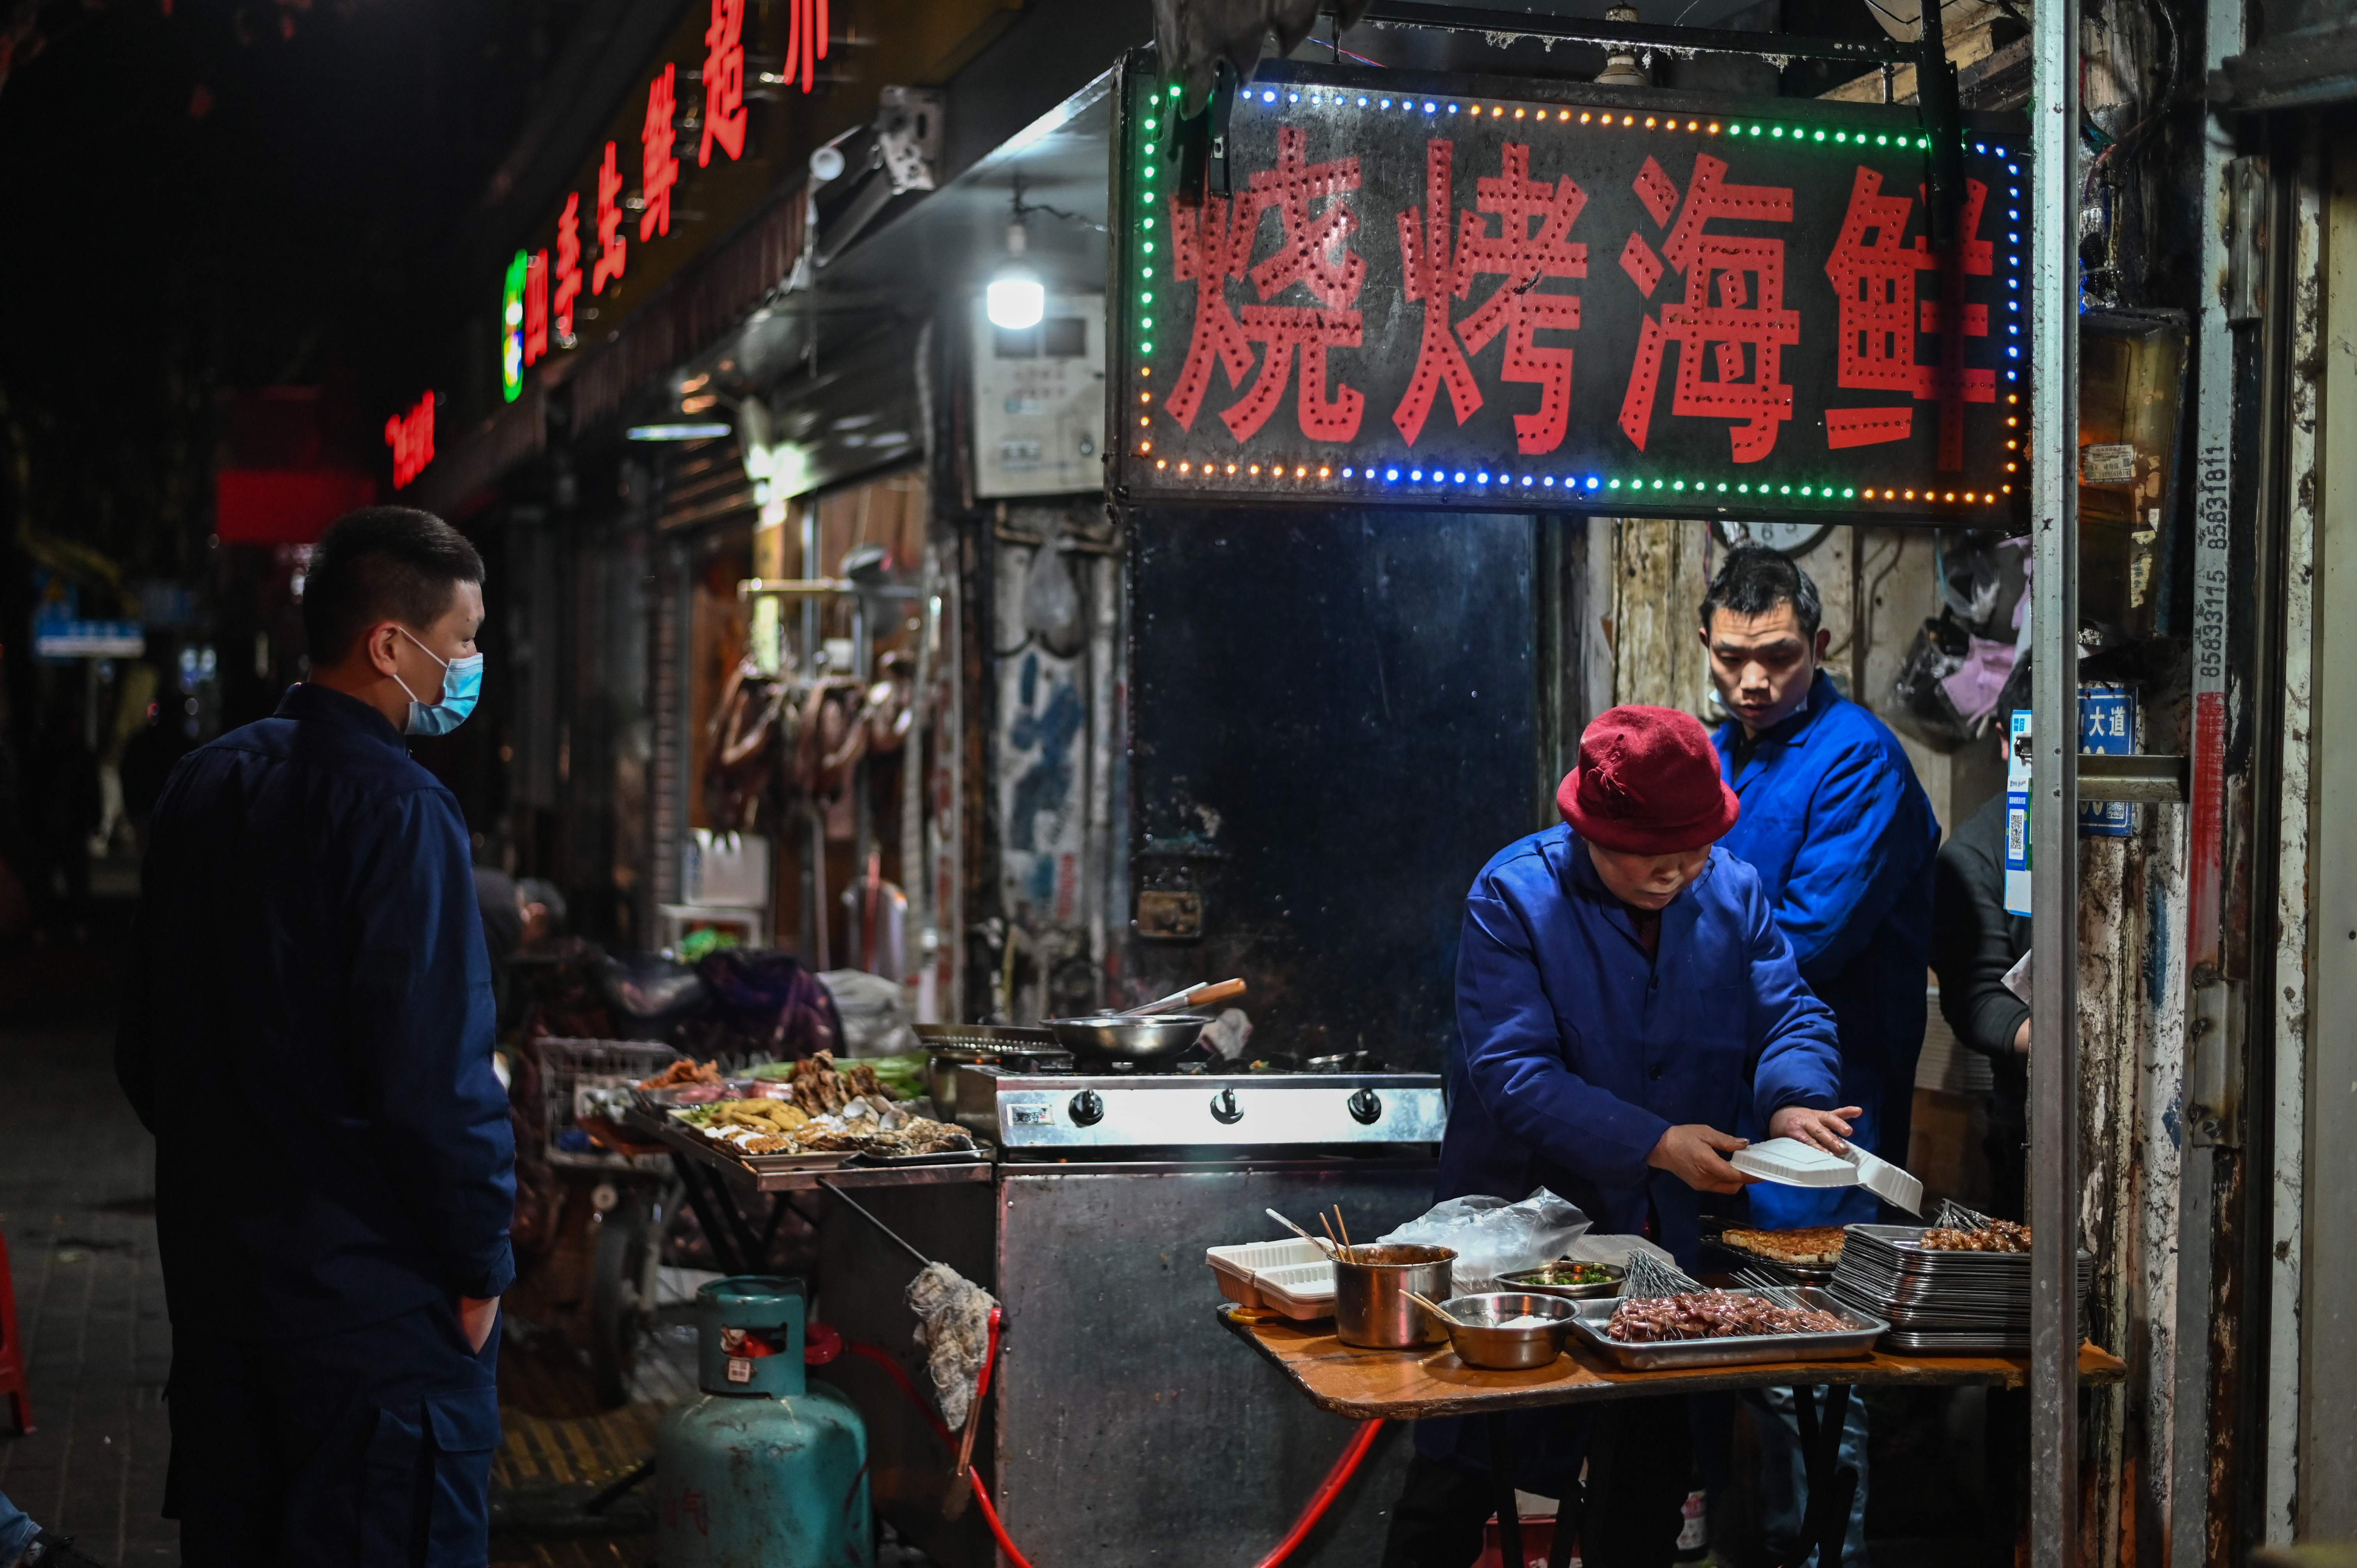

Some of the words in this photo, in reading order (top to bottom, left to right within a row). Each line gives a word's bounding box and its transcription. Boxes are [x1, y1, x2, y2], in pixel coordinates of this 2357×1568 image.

[1165, 127, 1996, 472] 烧烤海鲜
[2205, 446, 2227, 551] 85831811
[2200, 570, 2226, 678] 85833115
